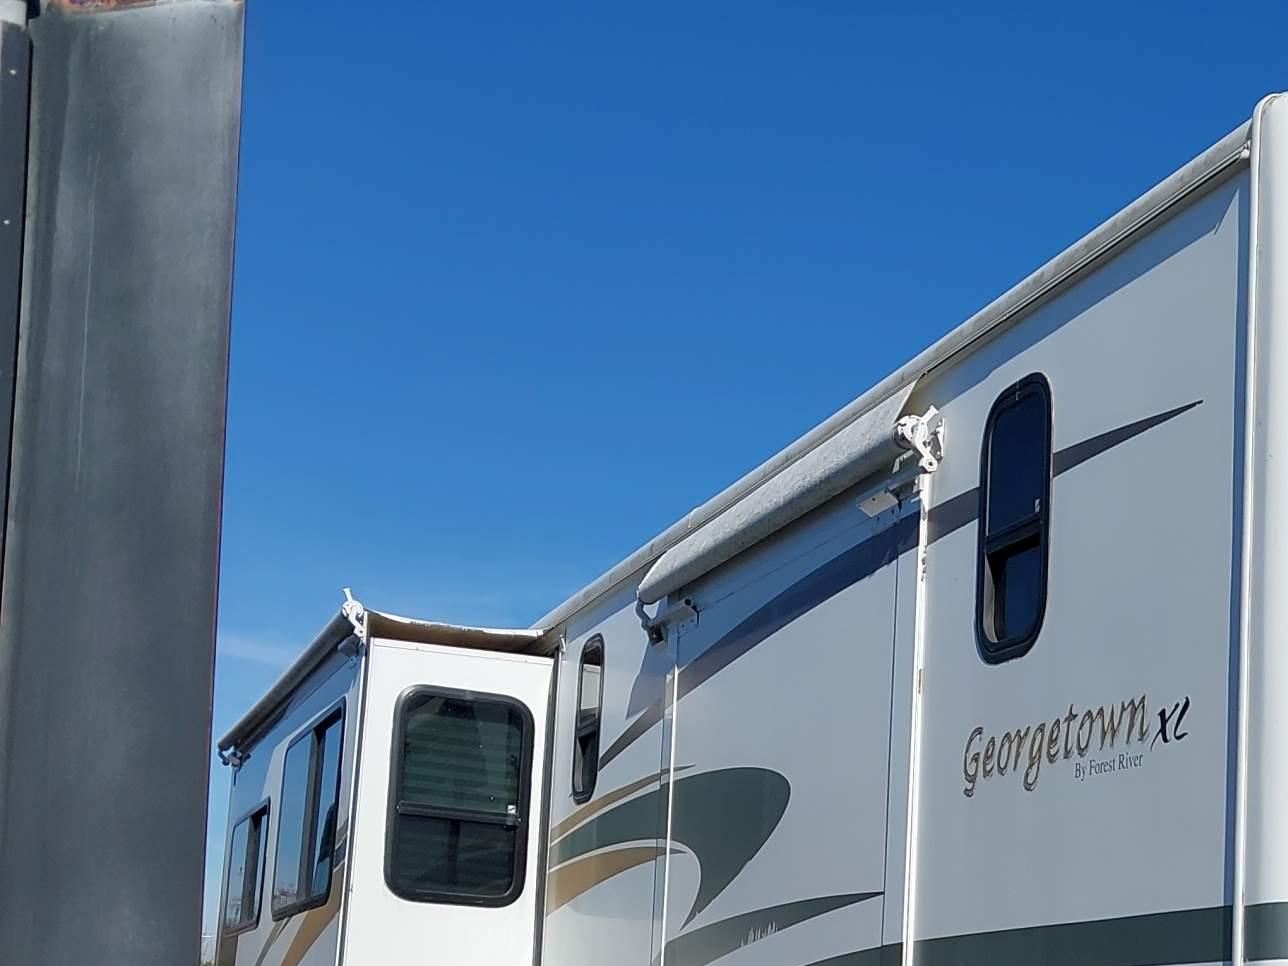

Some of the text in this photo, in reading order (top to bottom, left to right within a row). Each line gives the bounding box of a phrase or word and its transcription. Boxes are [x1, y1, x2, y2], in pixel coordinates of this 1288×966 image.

[963, 694, 1150, 798] Georgetown
[1075, 752, 1143, 781] By Forest River
